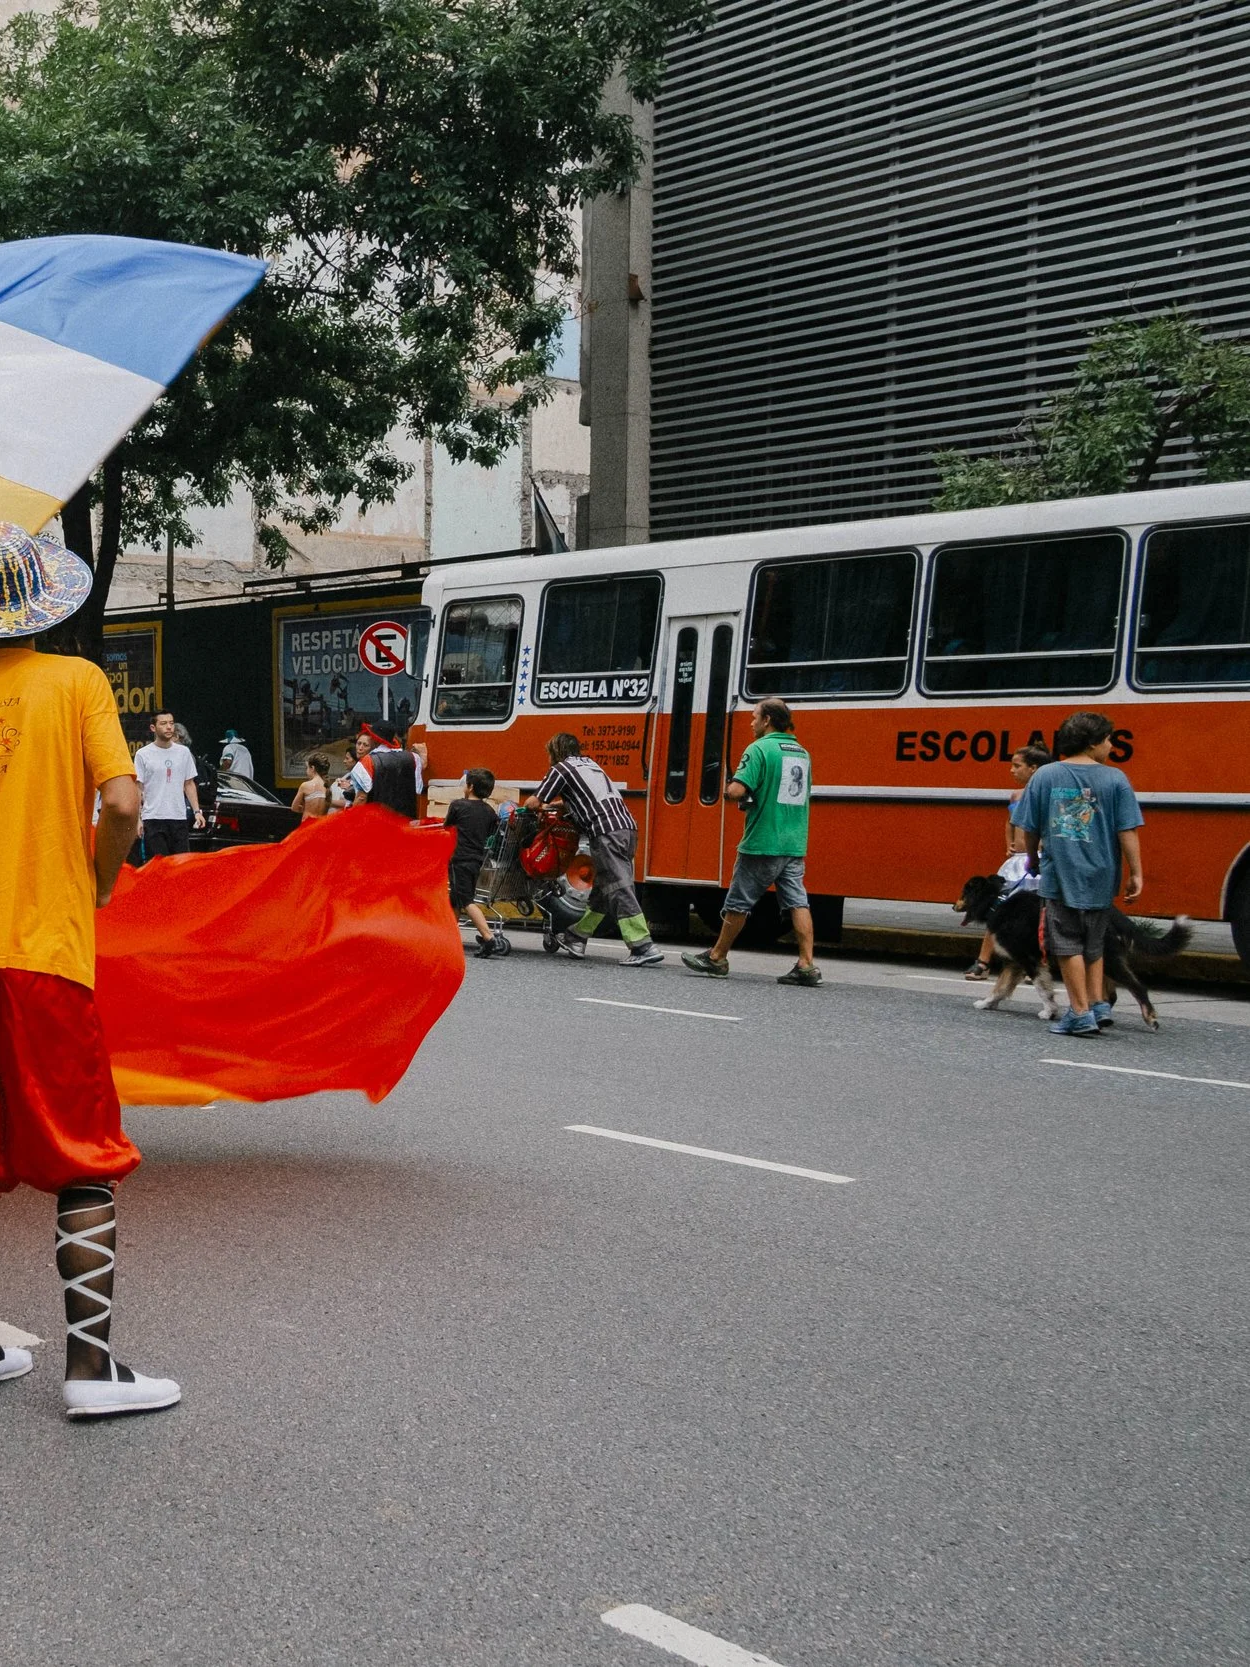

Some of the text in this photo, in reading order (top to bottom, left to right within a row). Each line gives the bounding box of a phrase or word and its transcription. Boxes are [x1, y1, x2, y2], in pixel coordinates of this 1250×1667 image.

[375, 634, 397, 663] E
[292, 653, 365, 676] VELOCID
[539, 680, 608, 699] ESCUELA
[896, 730, 1134, 763] ESCOLAS
